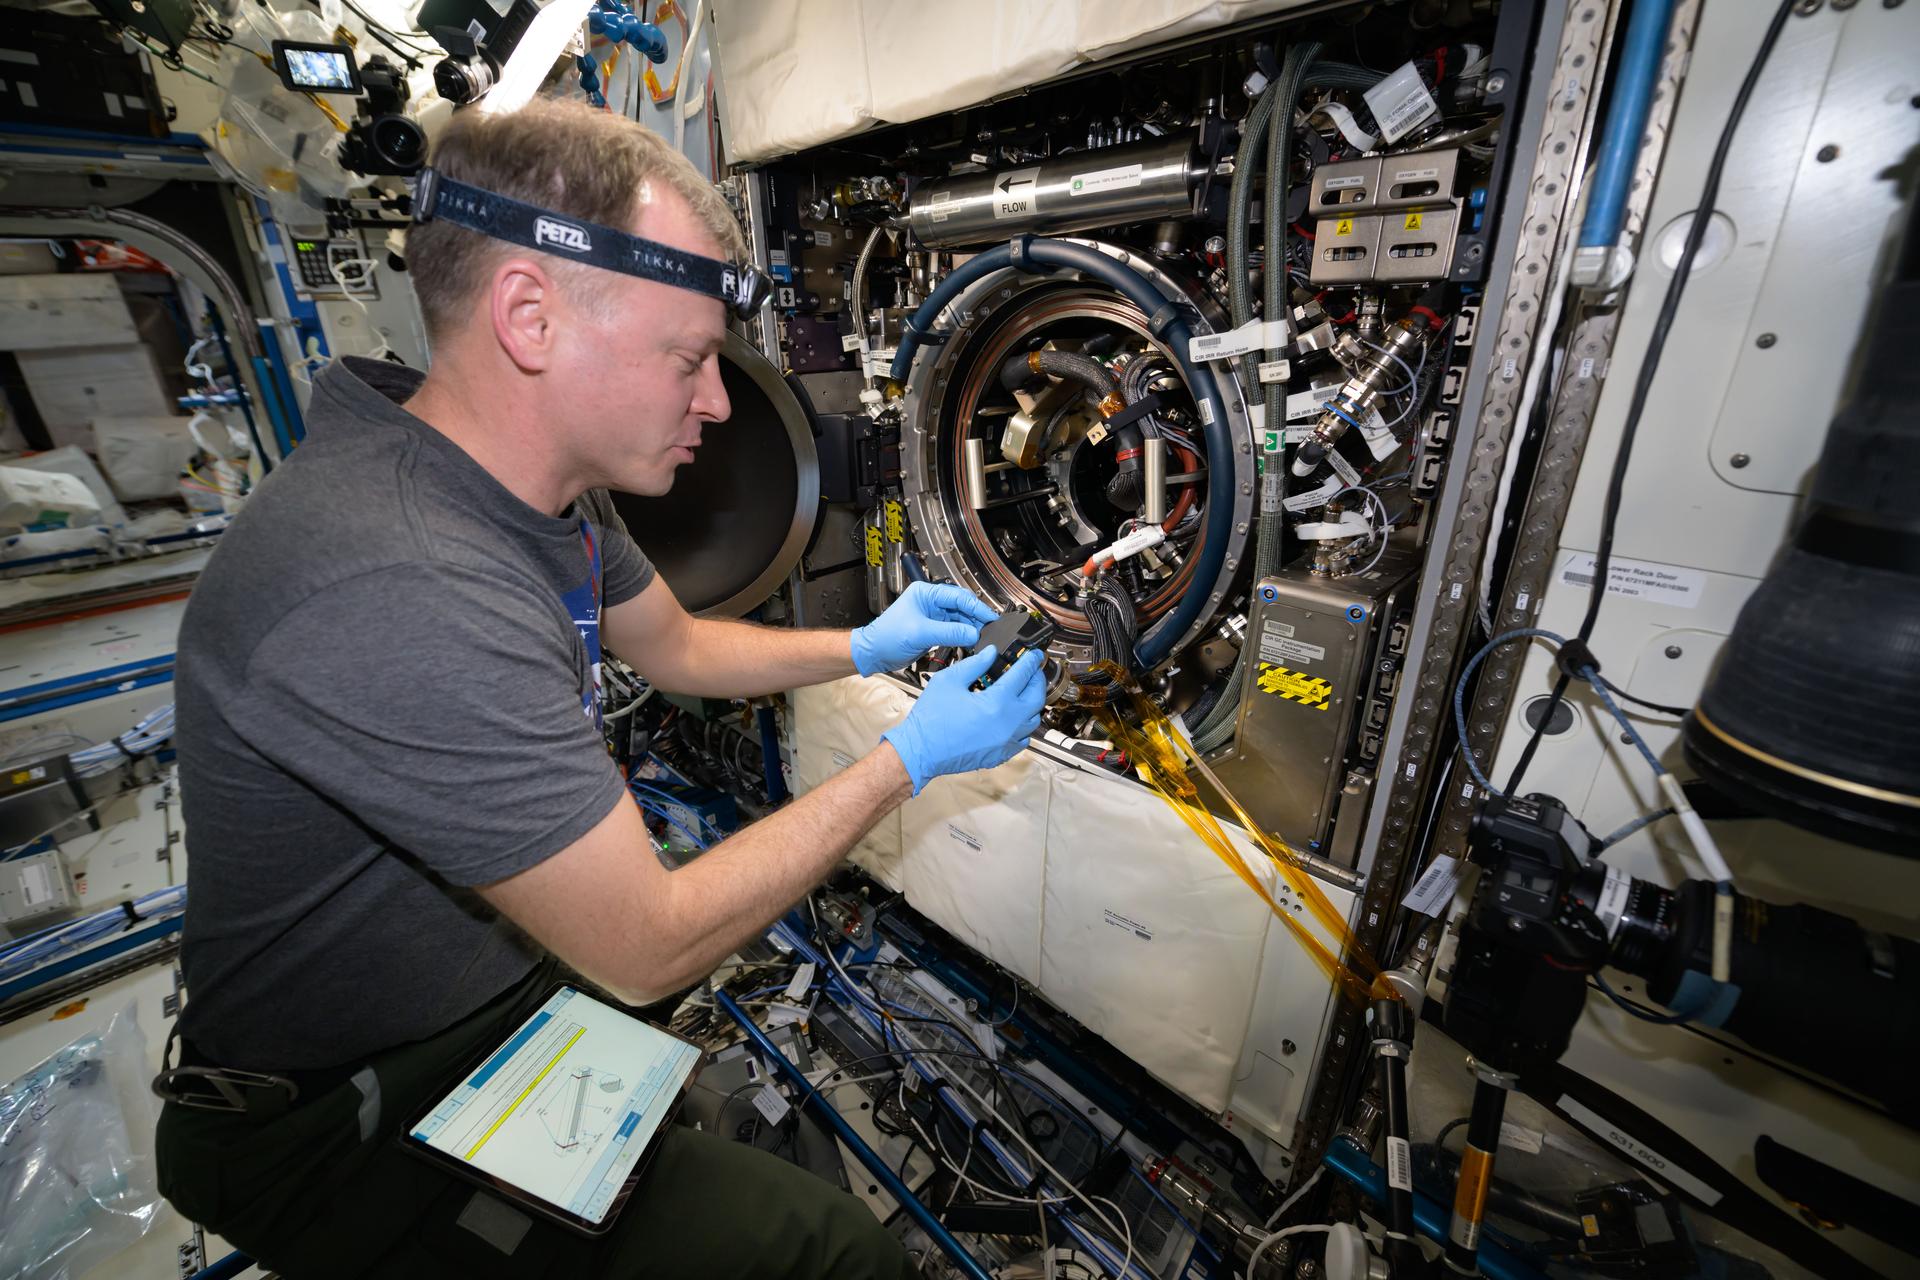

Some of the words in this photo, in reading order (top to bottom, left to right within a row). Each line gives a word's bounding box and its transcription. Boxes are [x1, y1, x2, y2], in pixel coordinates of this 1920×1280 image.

[440, 192, 487, 217] TIKKA
[1002, 201, 1027, 214] FLOW
[535, 218, 592, 251] PETZL
[632, 250, 686, 274] TIKKA
[1216, 350, 1234, 358] Return
[1235, 346, 1249, 354] Hose
[1633, 568, 1654, 577] Rack
[1655, 572, 1678, 581] Door
[1272, 671, 1301, 684] CAUTION
